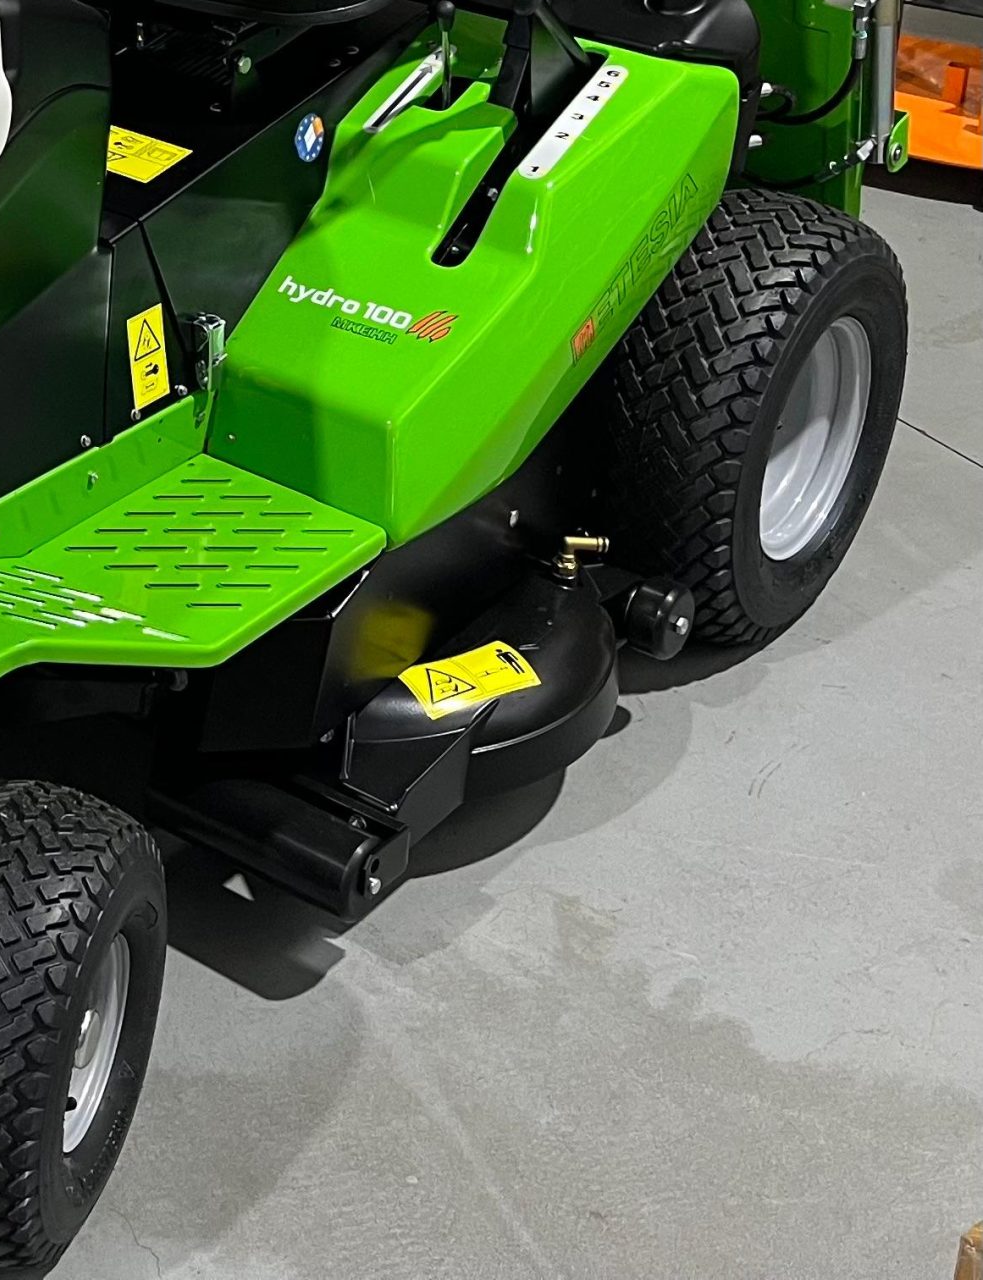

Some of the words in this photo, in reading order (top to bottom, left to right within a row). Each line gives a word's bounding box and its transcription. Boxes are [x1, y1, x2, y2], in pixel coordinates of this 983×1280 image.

[554, 131, 570, 140] 2
[530, 165, 540, 173] 1
[278, 275, 360, 315] hydro
[363, 301, 413, 330] 100
